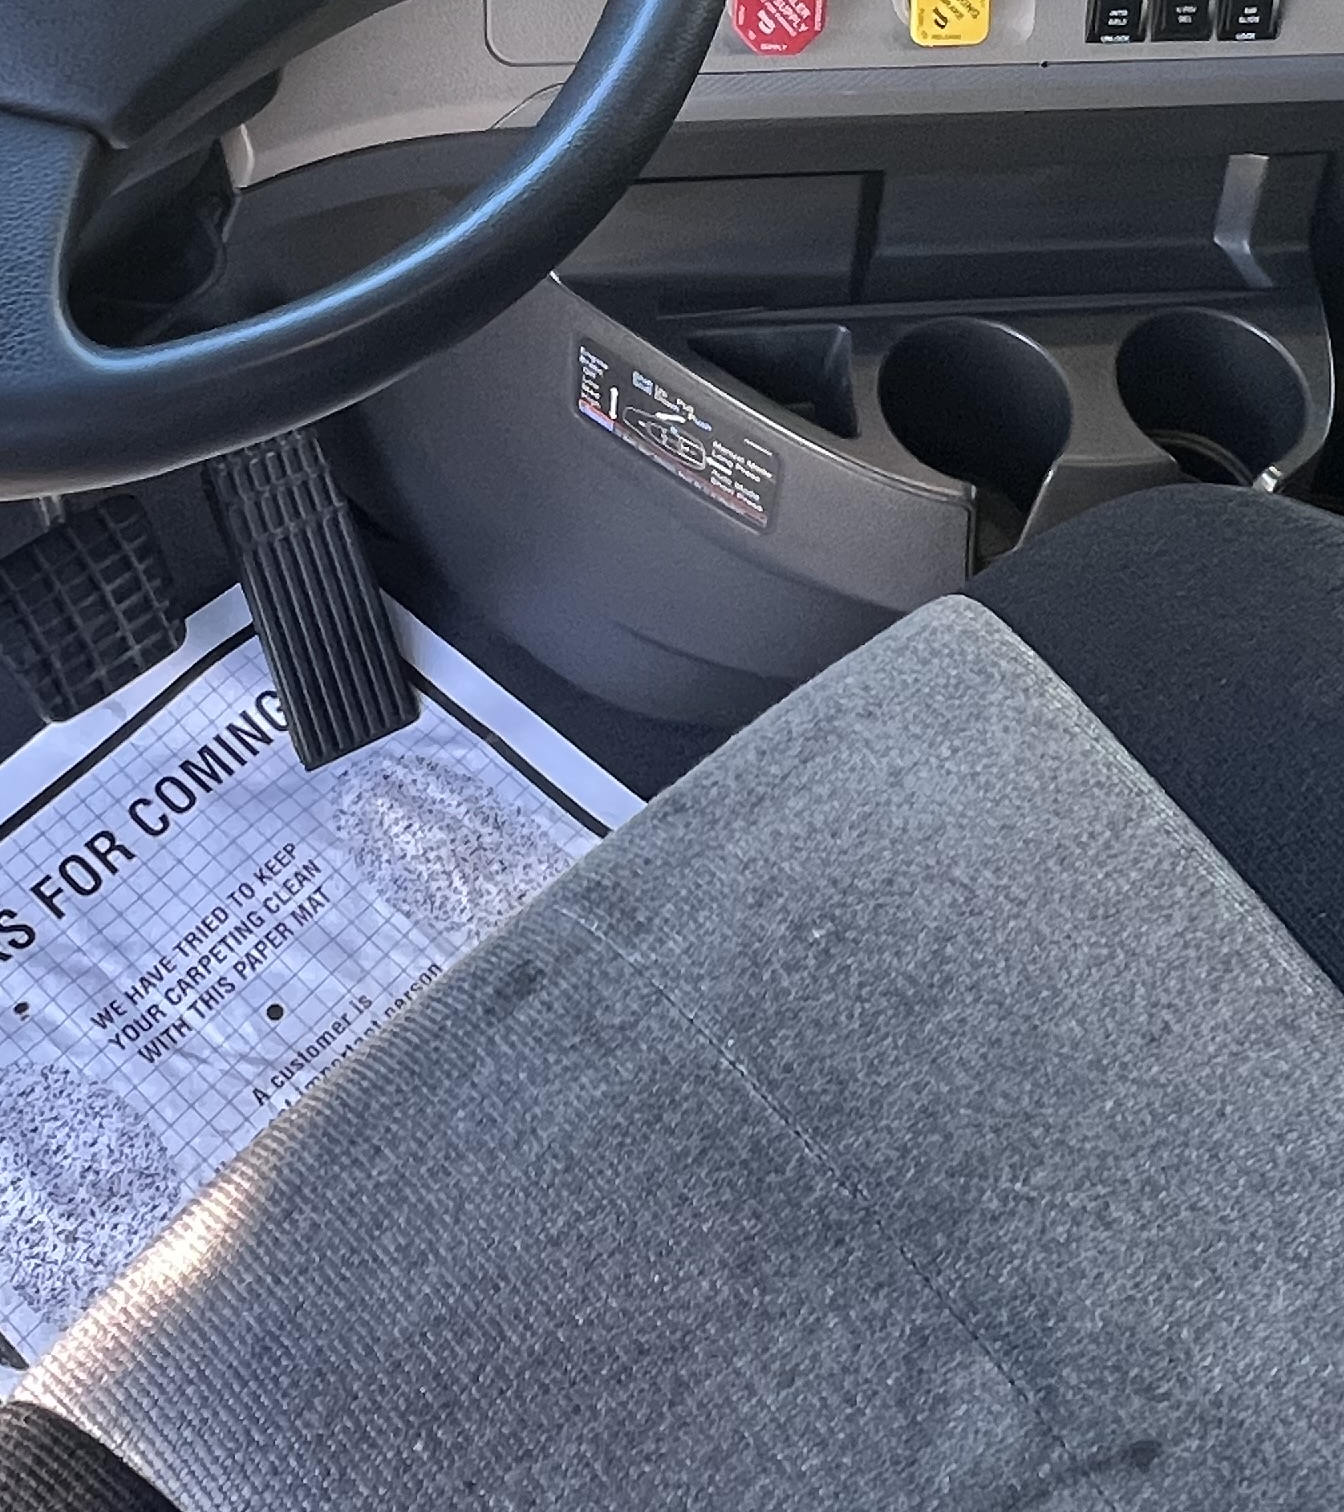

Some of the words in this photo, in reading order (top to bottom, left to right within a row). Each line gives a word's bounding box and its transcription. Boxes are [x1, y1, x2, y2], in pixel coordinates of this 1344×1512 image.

[31, 830, 136, 921] FOR
[128, 690, 290, 837] COMING
[90, 1000, 128, 1030] WE
[124, 955, 177, 1006] HAVE
[172, 906, 229, 958] TRIED
[227, 882, 255, 908] TO
[253, 842, 297, 886] KEEP
[108, 1003, 167, 1052] YOUR
[164, 911, 265, 1006] CARPETING
[263, 859, 322, 914] CLEAN
[137, 1015, 193, 1064] WITH
[187, 976, 236, 1019] THIS
[232, 922, 294, 980] PAPER
[290, 887, 331, 927] MAT
[252, 1088, 272, 1107] A
[270, 1013, 352, 1089] customer
[349, 995, 374, 1016] is
